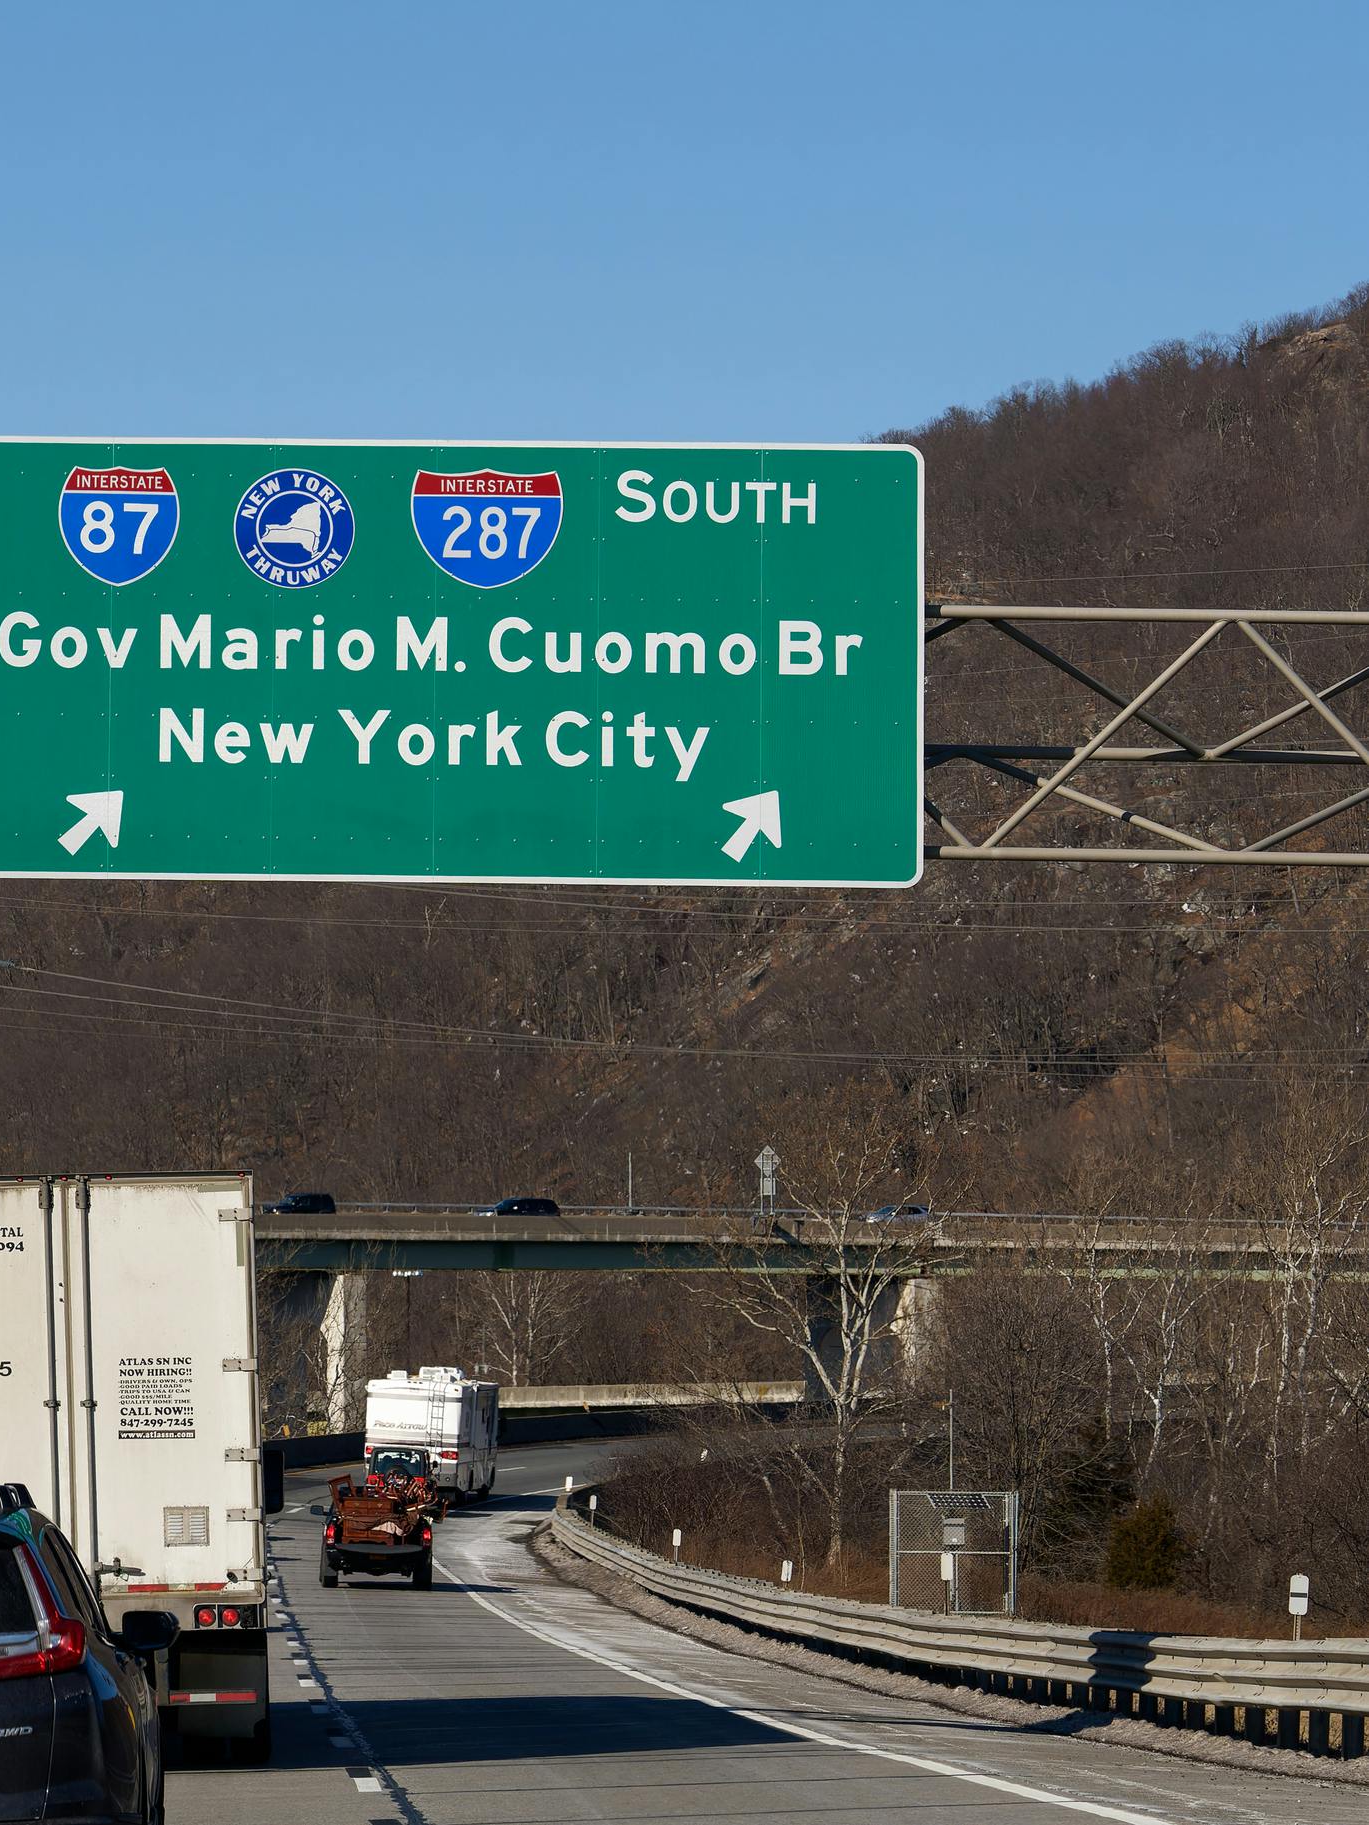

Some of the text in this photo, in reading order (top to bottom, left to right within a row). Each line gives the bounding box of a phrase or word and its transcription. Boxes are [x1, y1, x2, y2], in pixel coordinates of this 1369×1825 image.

[76, 475, 163, 489] INTERSTATE
[240, 473, 346, 520] NEW YORK
[440, 479, 534, 493] INTERSTATE
[615, 470, 816, 523] SOUTH
[81, 501, 158, 554] 87
[443, 506, 539, 559] 287
[245, 544, 343, 585] THRUWAY
[160, 614, 374, 671] Mario
[396, 616, 466, 672] M.
[489, 617, 756, 675] Cuomo
[779, 621, 862, 675] Br
[159, 708, 709, 781] New York City
[119, 1358, 153, 1366] ATLAS
[173, 1357, 192, 1365] INC
[119, 1368, 192, 1377] NOW HIRING!!
[120, 1406, 194, 1416] CALL NOW!!!
[120, 1418, 194, 1427] 847-299-7245
